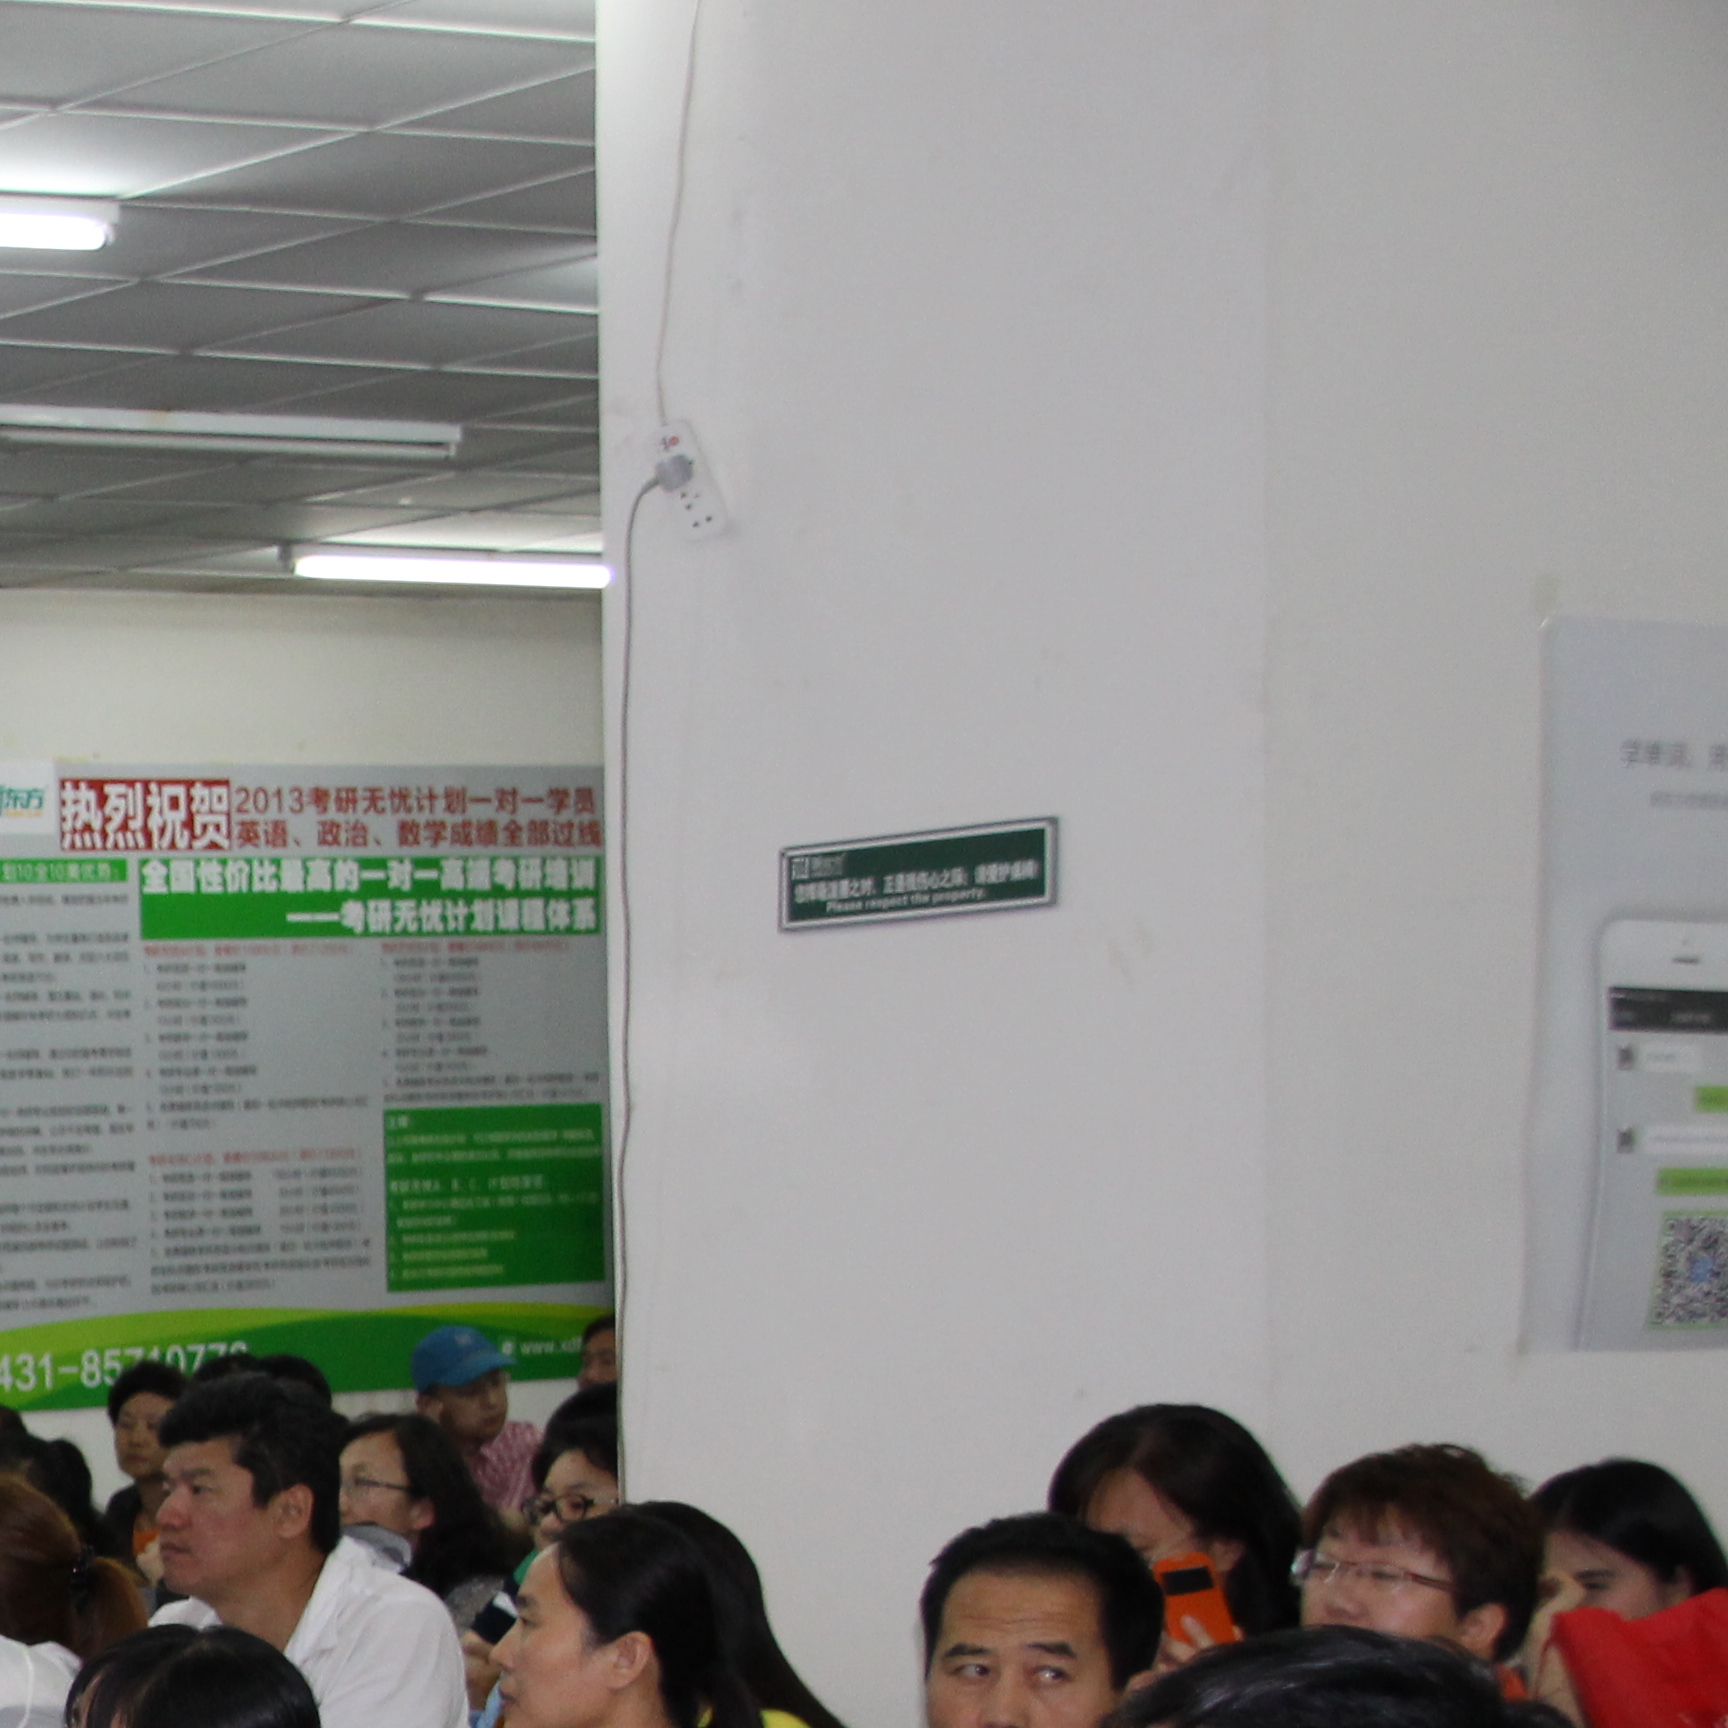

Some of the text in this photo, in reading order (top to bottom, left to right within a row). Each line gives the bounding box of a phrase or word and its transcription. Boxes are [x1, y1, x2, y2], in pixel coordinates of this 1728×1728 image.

[60, 781, 231, 850] 热烈祝贺
[234, 786, 597, 815] 2013考研无忧计划一对一学员
